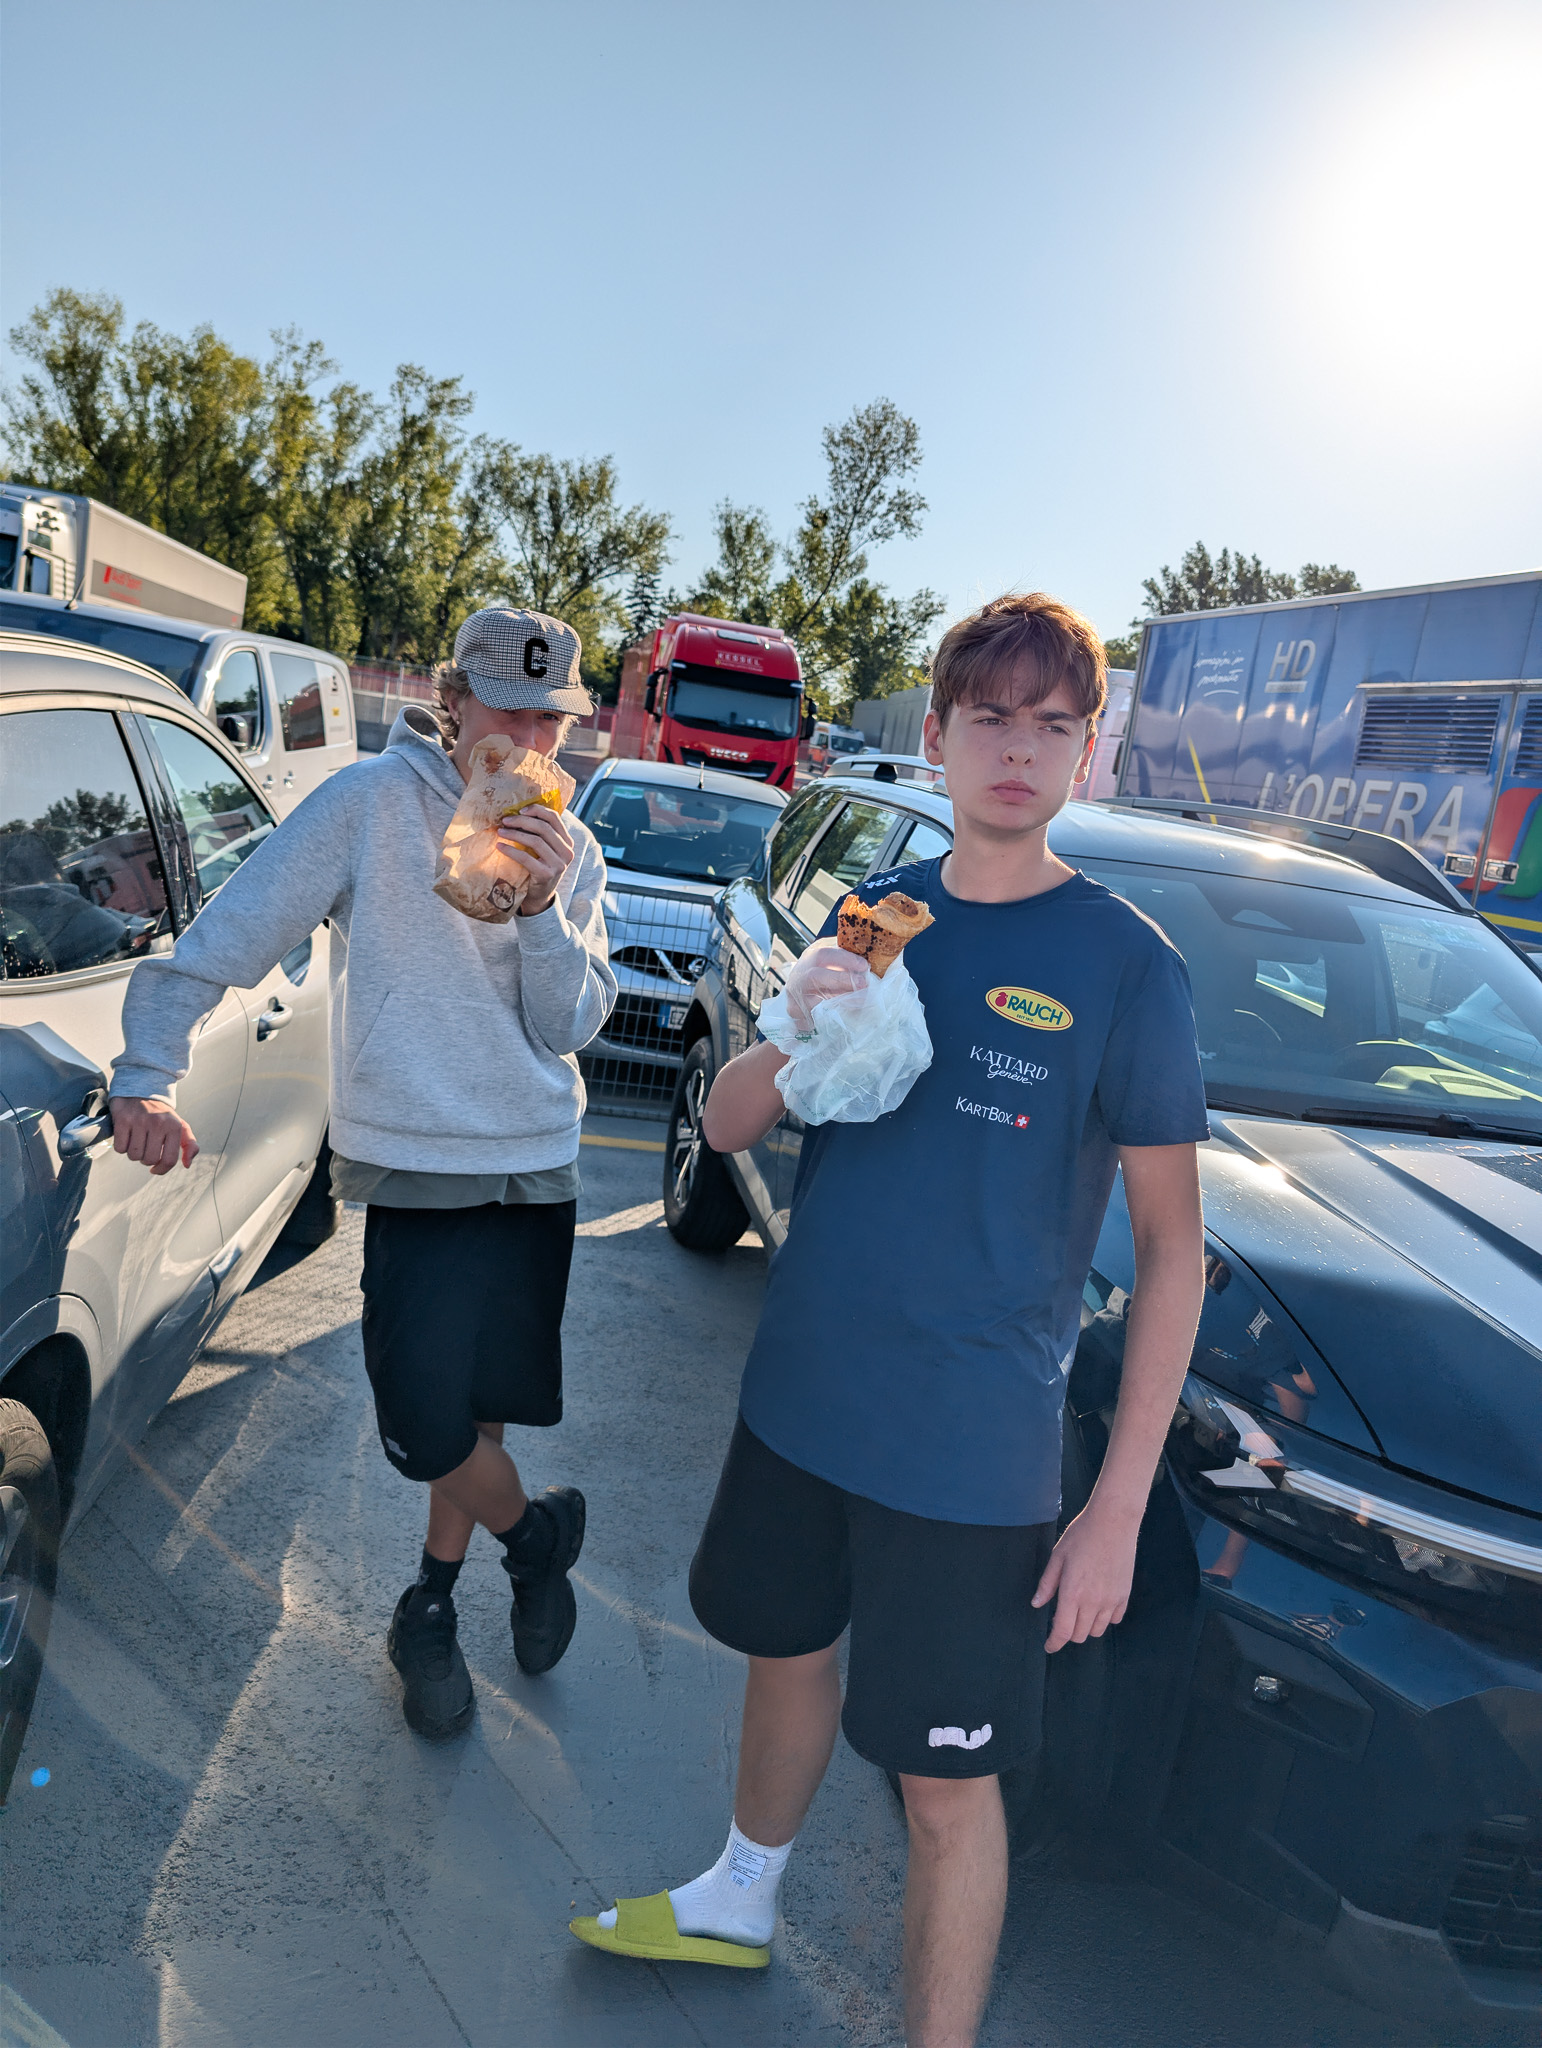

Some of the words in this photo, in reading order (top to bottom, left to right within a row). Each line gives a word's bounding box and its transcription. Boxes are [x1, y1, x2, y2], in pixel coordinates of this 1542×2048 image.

[524, 638, 549, 678] C
[1268, 639, 1316, 681] HD
[710, 747, 749, 761] IVECO
[1251, 772, 1464, 851] L'OPERA
[1007, 995, 1063, 1025] RAUCH
[970, 1045, 1048, 1081] KATTARD
[987, 1063, 1033, 1086] Genève
